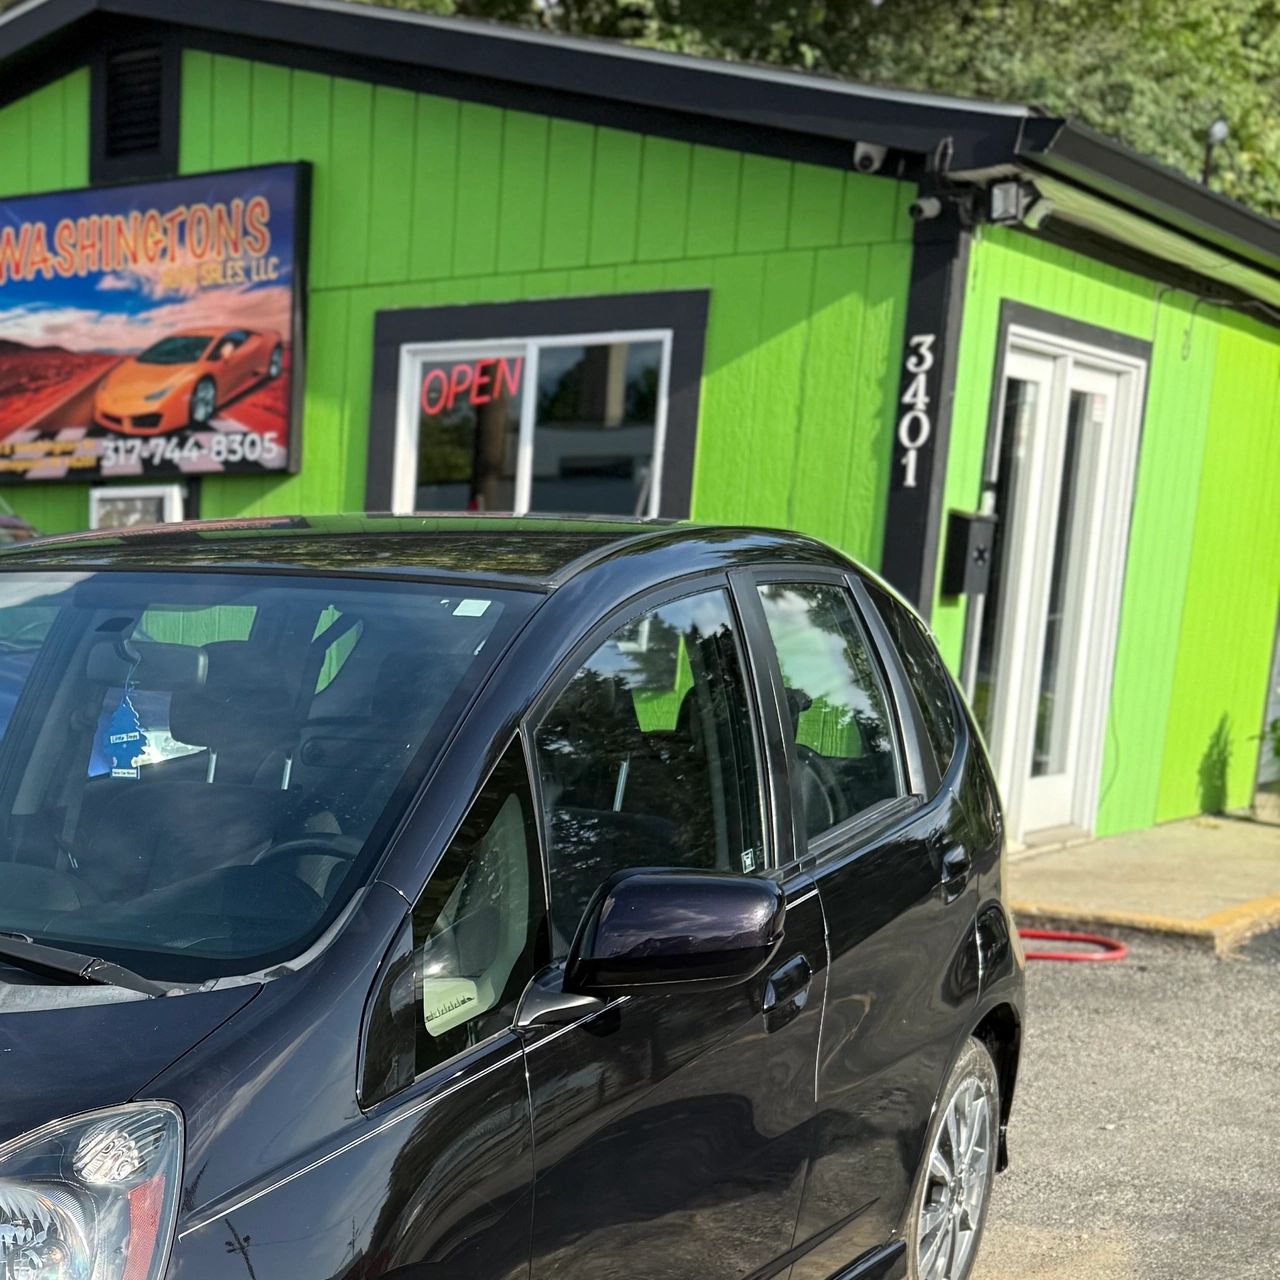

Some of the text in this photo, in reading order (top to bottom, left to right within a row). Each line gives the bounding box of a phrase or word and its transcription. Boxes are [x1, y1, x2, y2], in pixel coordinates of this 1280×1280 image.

[251, 257, 279, 281] LLC
[421, 356, 522, 416] OPEN
[898, 334, 935, 487] 3401
